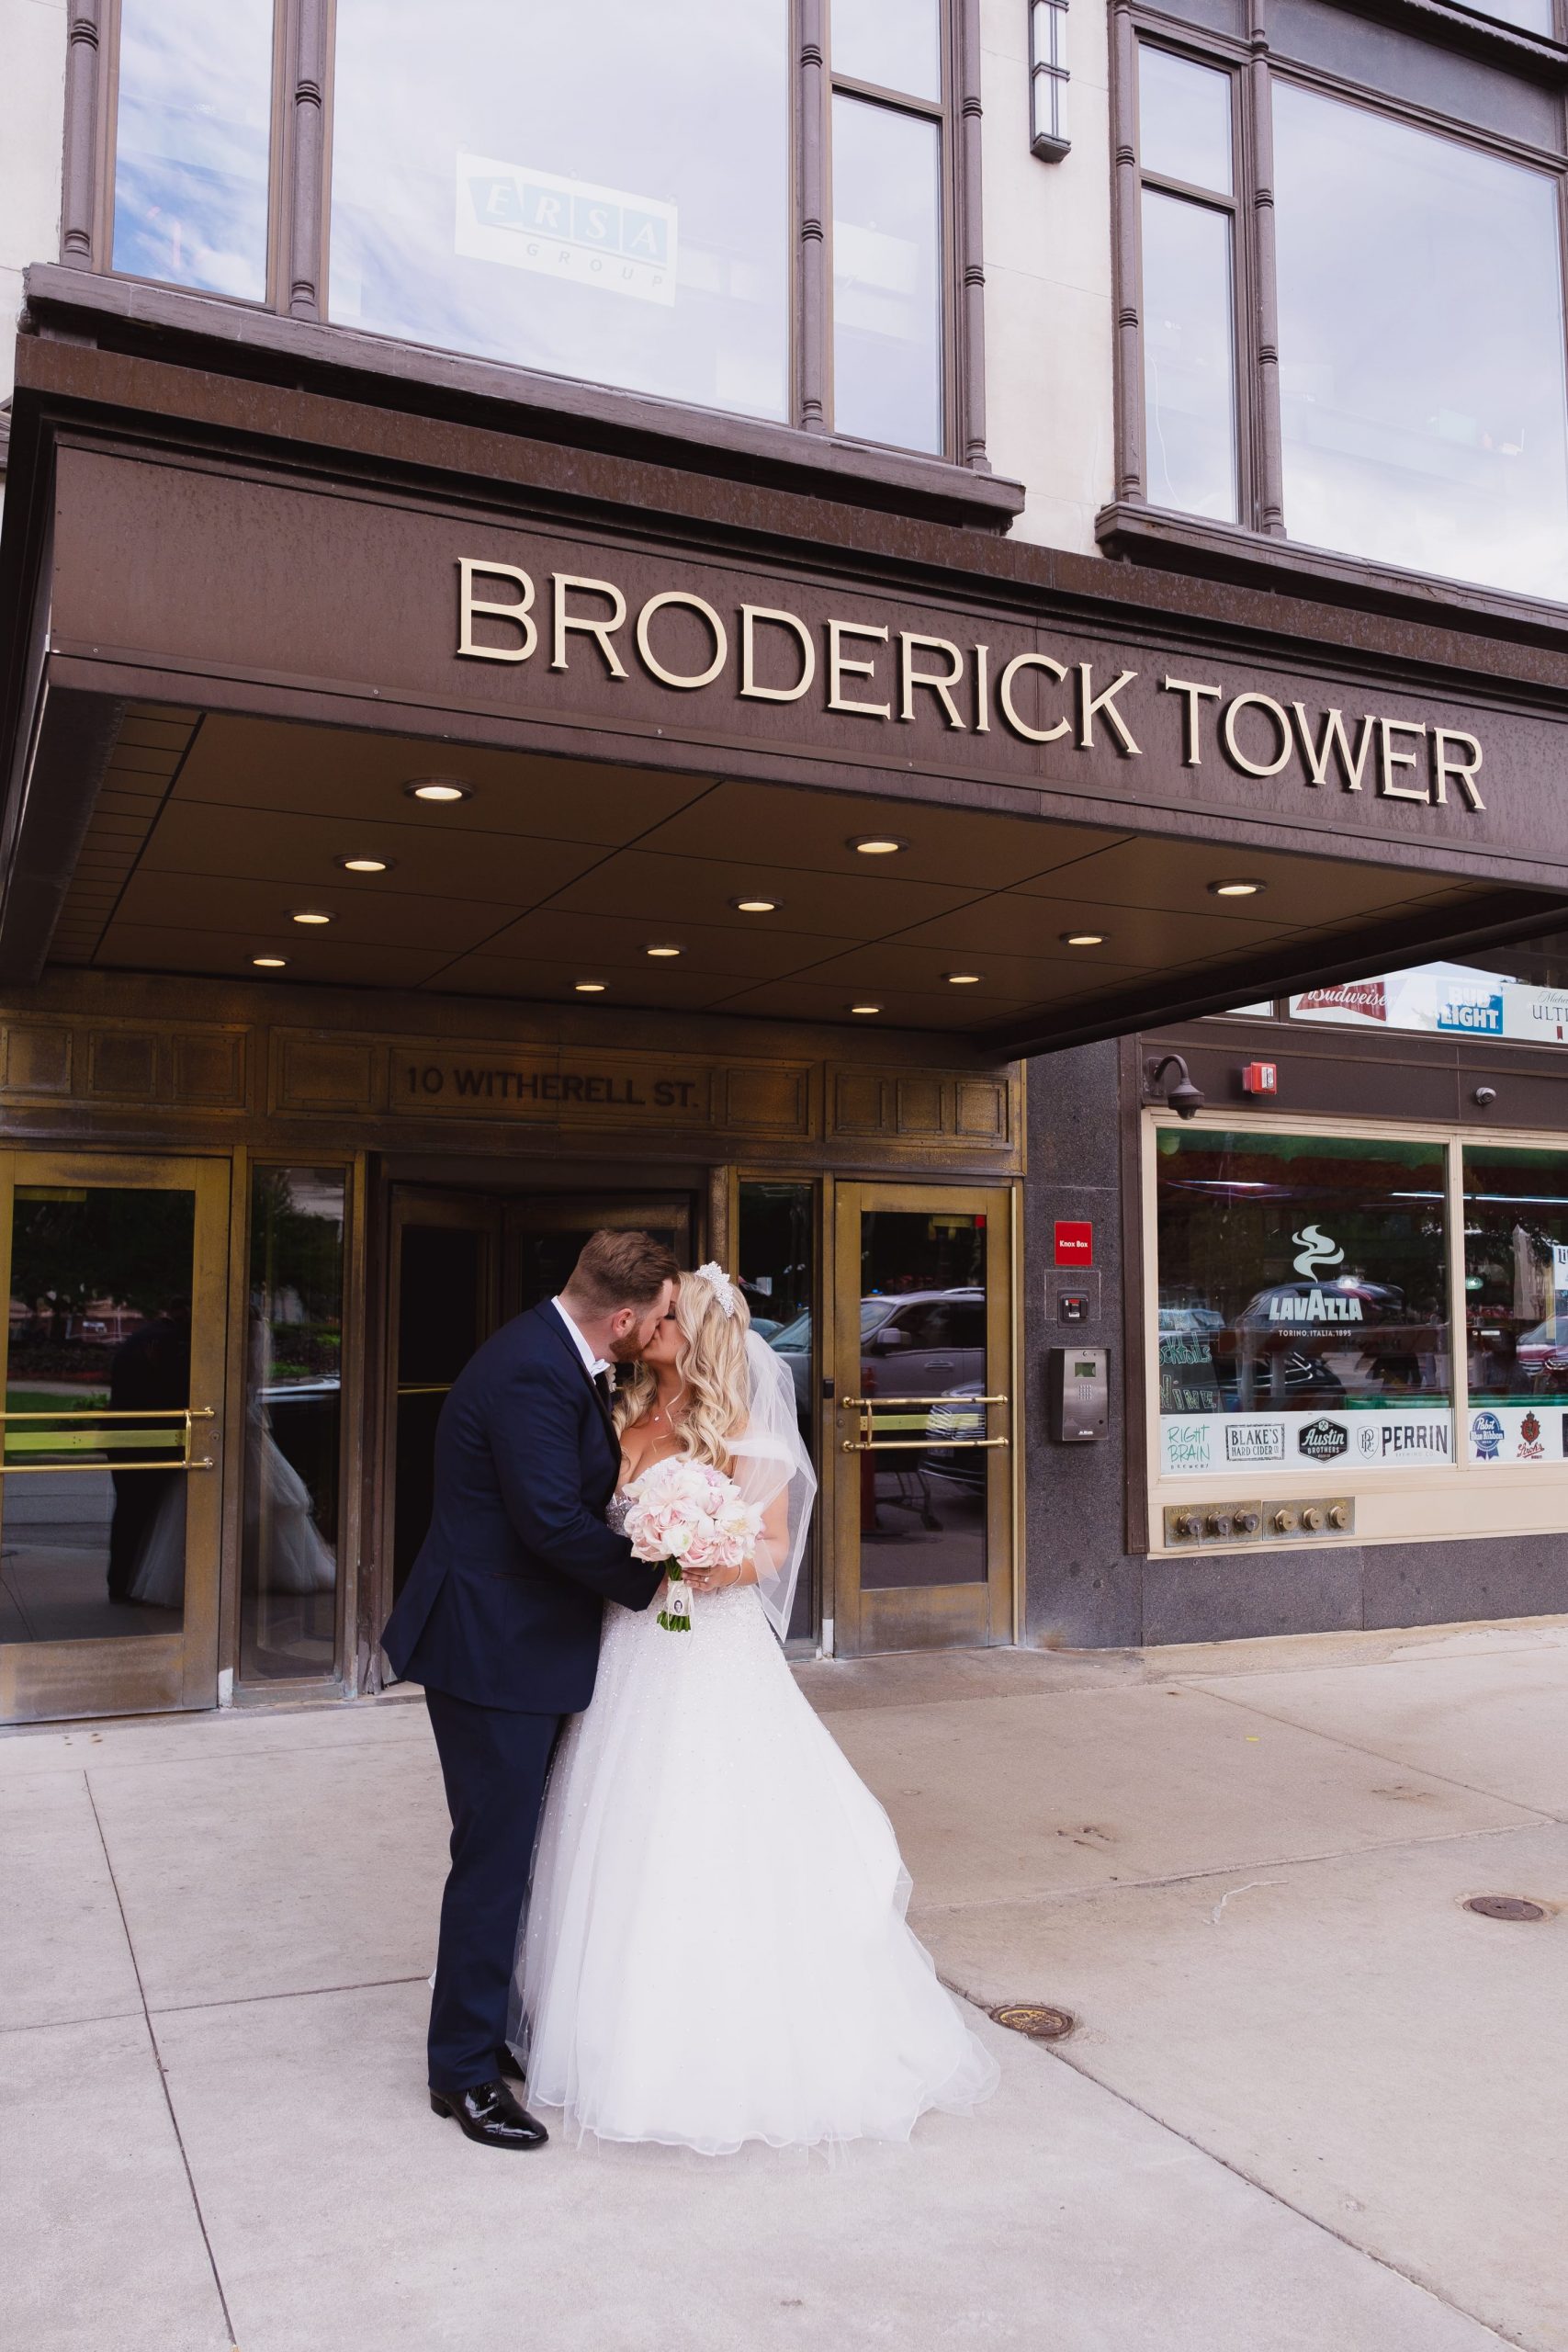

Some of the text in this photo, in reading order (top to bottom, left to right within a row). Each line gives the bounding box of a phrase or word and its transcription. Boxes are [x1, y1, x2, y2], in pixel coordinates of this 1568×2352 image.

[485, 184, 660, 255] ERSA
[526, 242, 663, 288] GROUP
[457, 557, 1486, 810] BRODERICK TOWER
[1308, 983, 1391, 1006] Budweise
[1441, 1004, 1499, 1028] LIGHT
[409, 1068, 700, 1108] 10 WITHERELL ST.
[1269, 1288, 1364, 1321] LAVAZZA
[1168, 1424, 1211, 1443] RIGHT
[1477, 1418, 1495, 1430] Pabst
[1232, 1429, 1280, 1445] BLAKE'S
[1302, 1428, 1345, 1446] Austin
[1382, 1425, 1448, 1456] PERRIN
[1483, 1430, 1504, 1441] Ribbon
[1168, 1443, 1211, 1461] BRAIN
[1232, 1447, 1251, 1457] HARD
[1252, 1445, 1273, 1456] CIDER
[1307, 1446, 1340, 1454] BROTHERS
